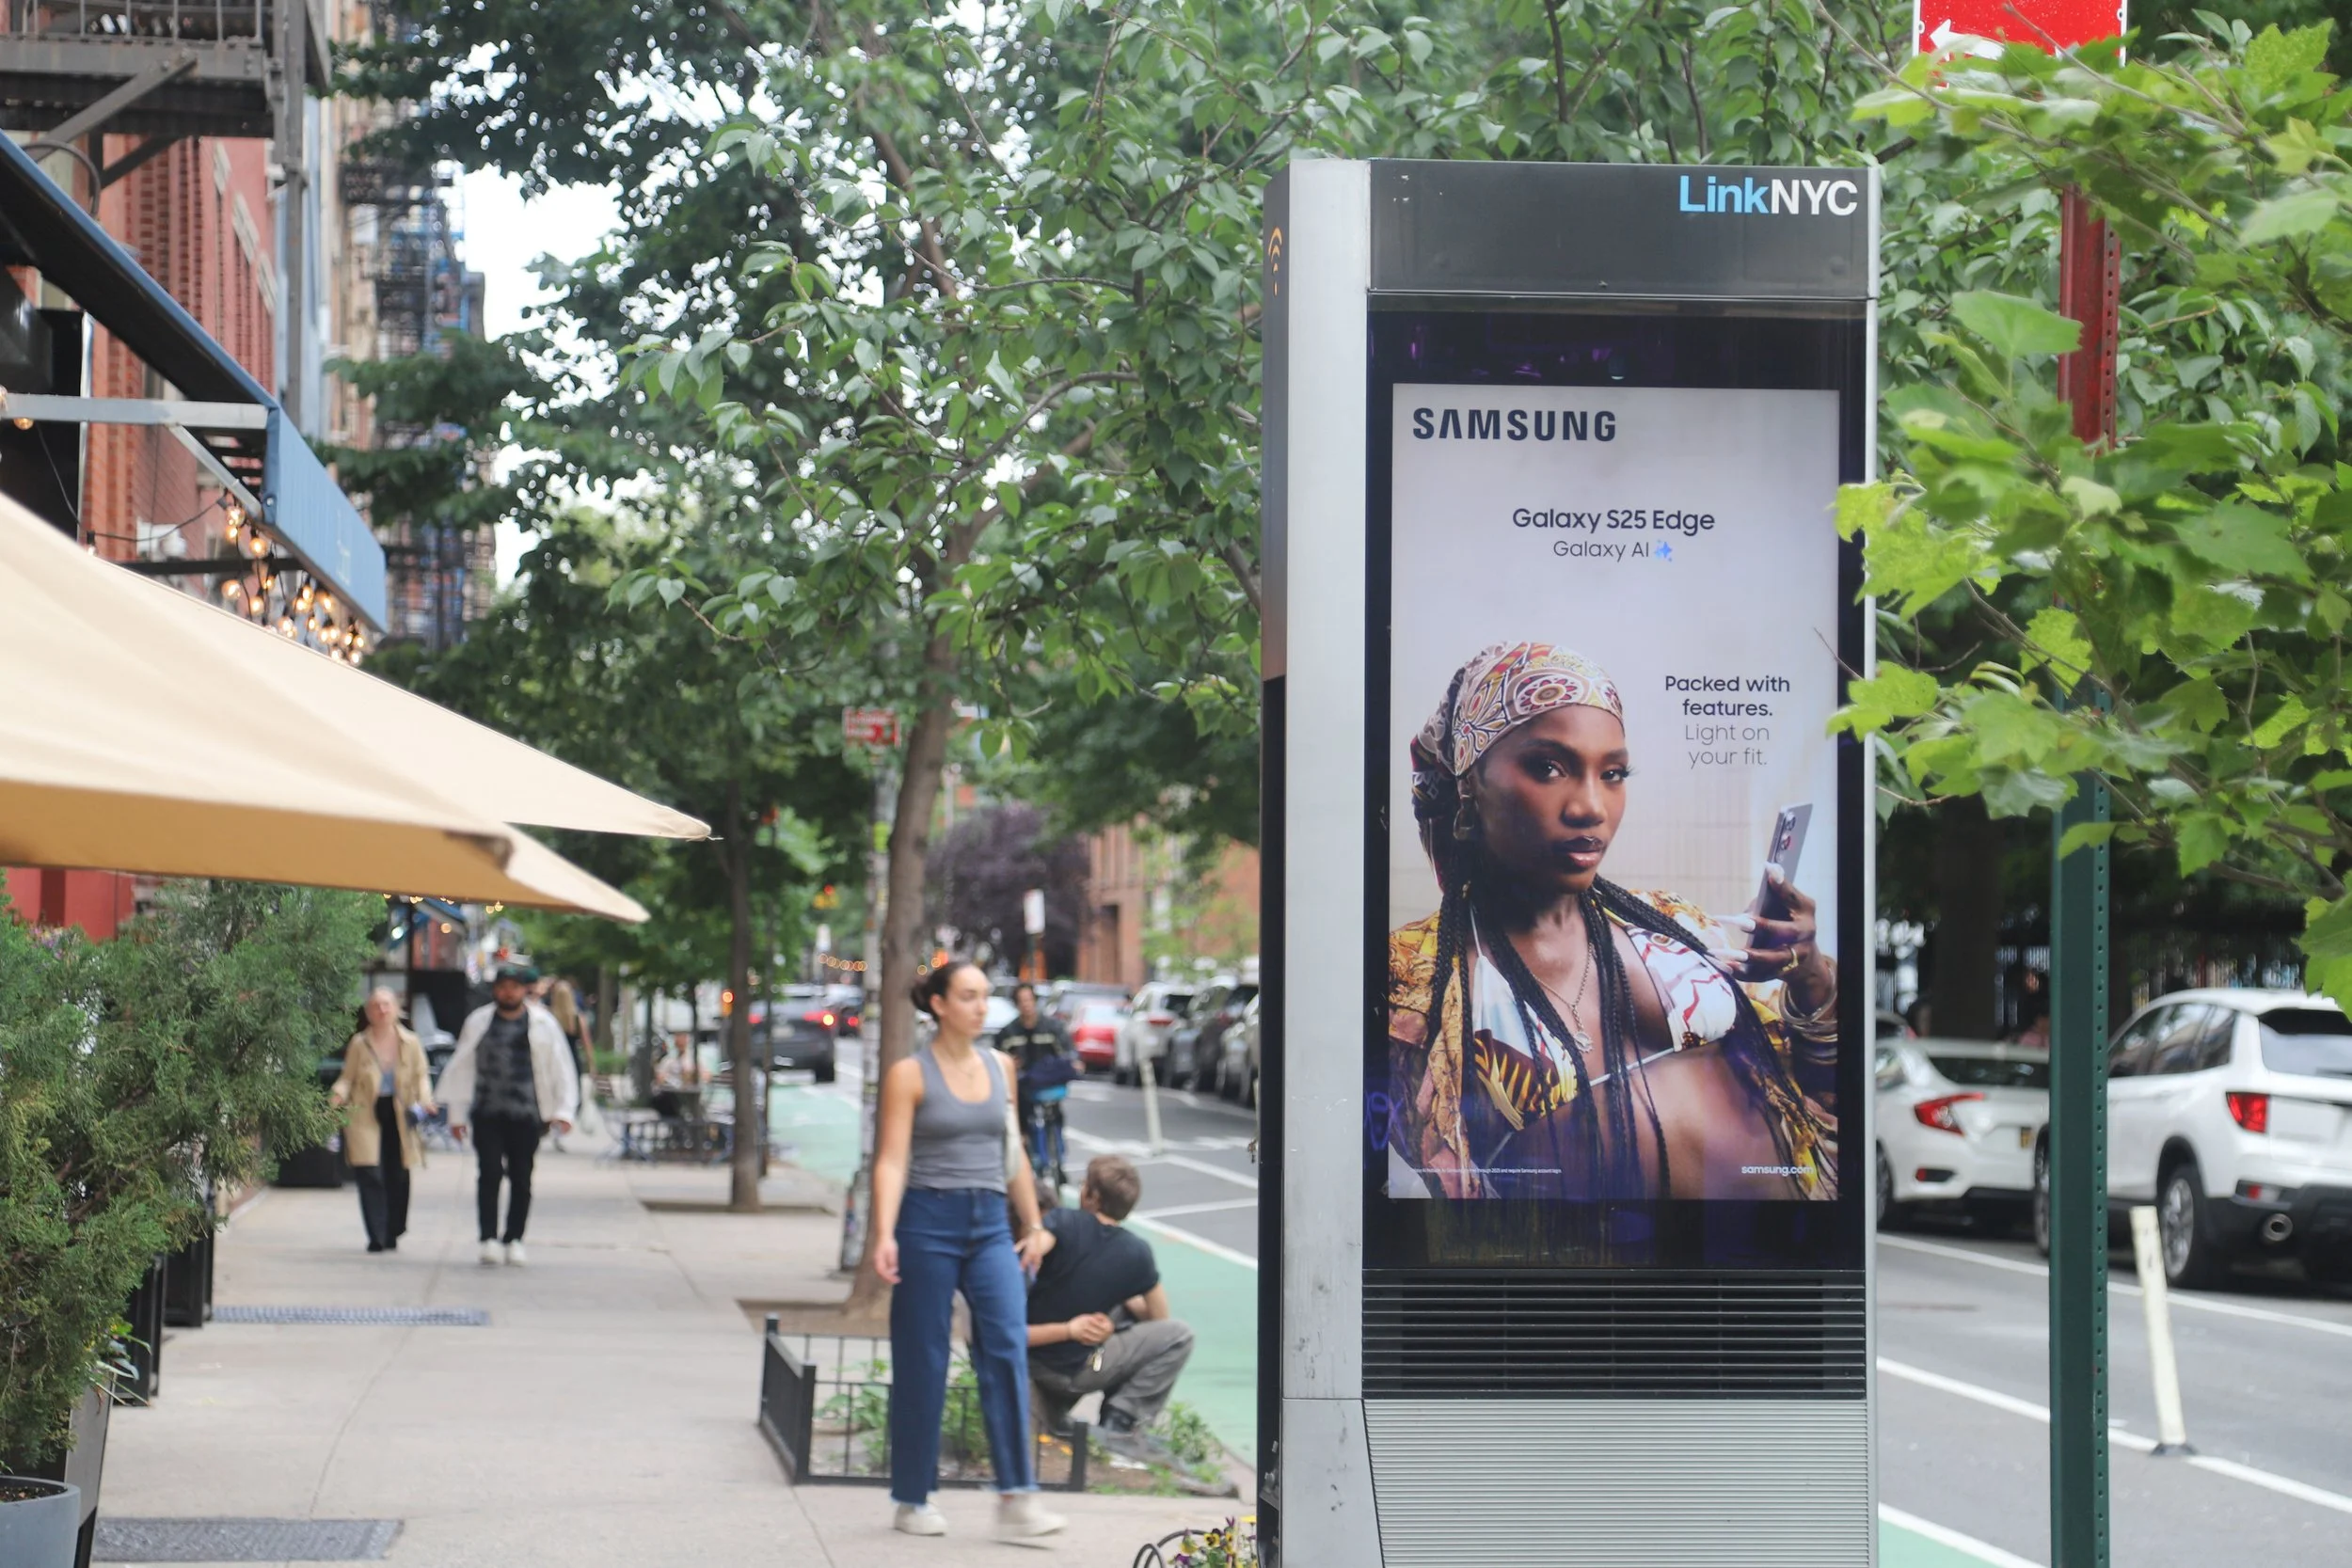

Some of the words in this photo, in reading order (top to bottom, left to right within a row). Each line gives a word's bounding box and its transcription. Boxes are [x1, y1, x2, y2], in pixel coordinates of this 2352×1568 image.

[1679, 175, 1858, 215] LinkNYC
[1412, 407, 1616, 442] SAMSUNG
[1512, 508, 1601, 534] Galaxy
[1606, 510, 1646, 530] S25
[1653, 510, 1715, 536] Edge
[1553, 540, 1627, 562] Galaxy
[1631, 541, 1649, 558] AI
[1665, 675, 1740, 692] Packed
[1745, 675, 1790, 692] with
[1682, 698, 1773, 717] features.
[1685, 723, 1736, 746] Light
[1741, 726, 1770, 741] on
[1688, 751, 1738, 769] your
[1743, 747, 1768, 766] fit.
[1740, 1165, 1815, 1177] samsung.com
